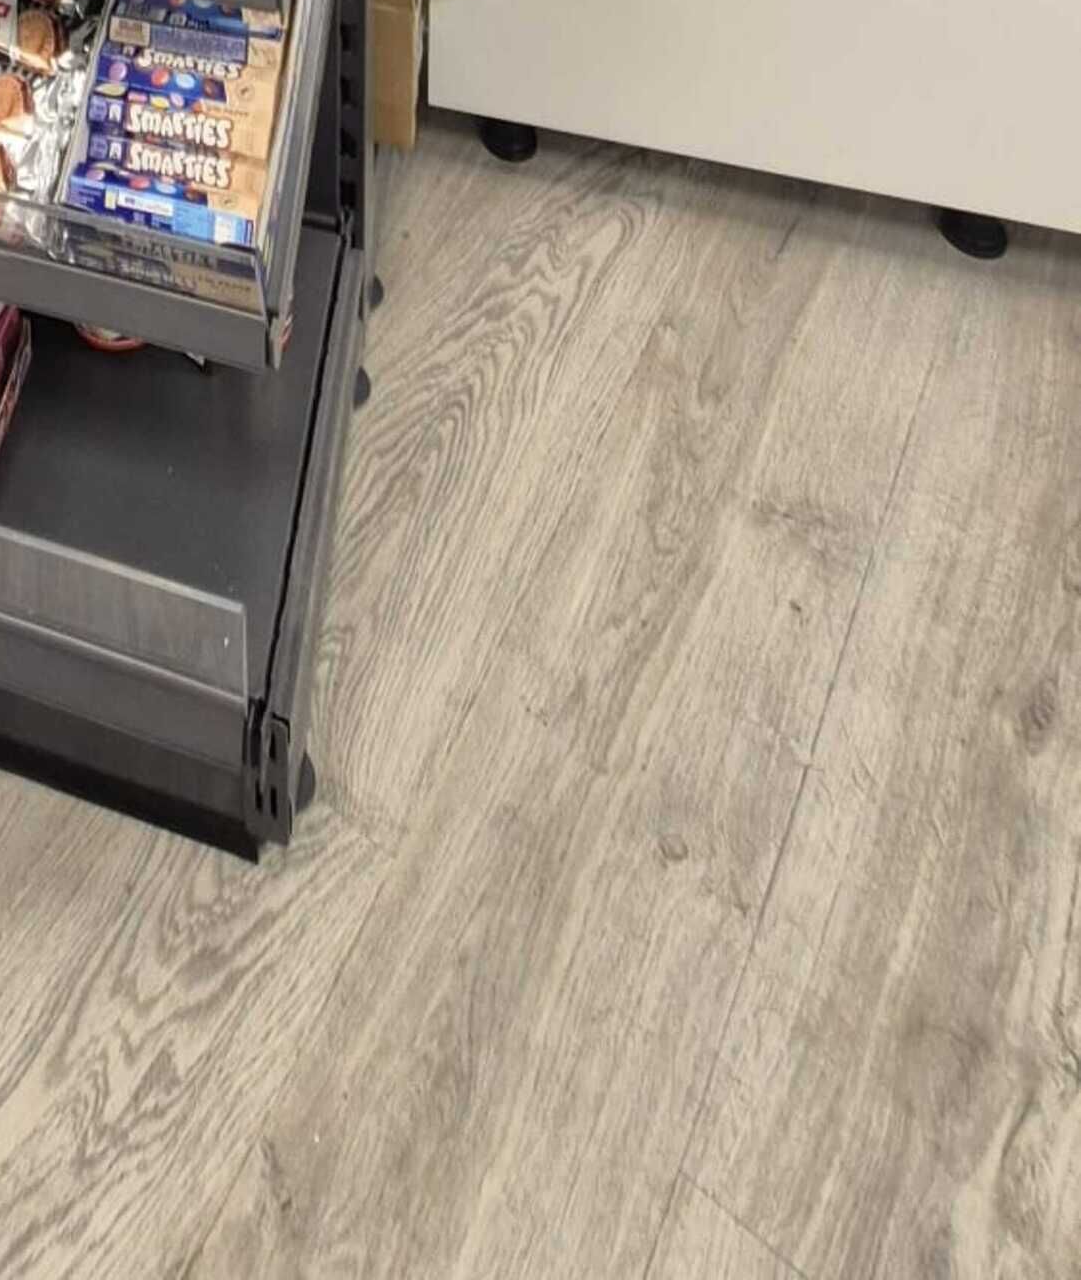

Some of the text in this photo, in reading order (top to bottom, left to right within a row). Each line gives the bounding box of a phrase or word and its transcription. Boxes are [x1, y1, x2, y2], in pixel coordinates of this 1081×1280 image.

[137, 48, 242, 80] SMARTIES
[126, 103, 234, 150] SMARTIES
[126, 139, 233, 190] SMARTIES
